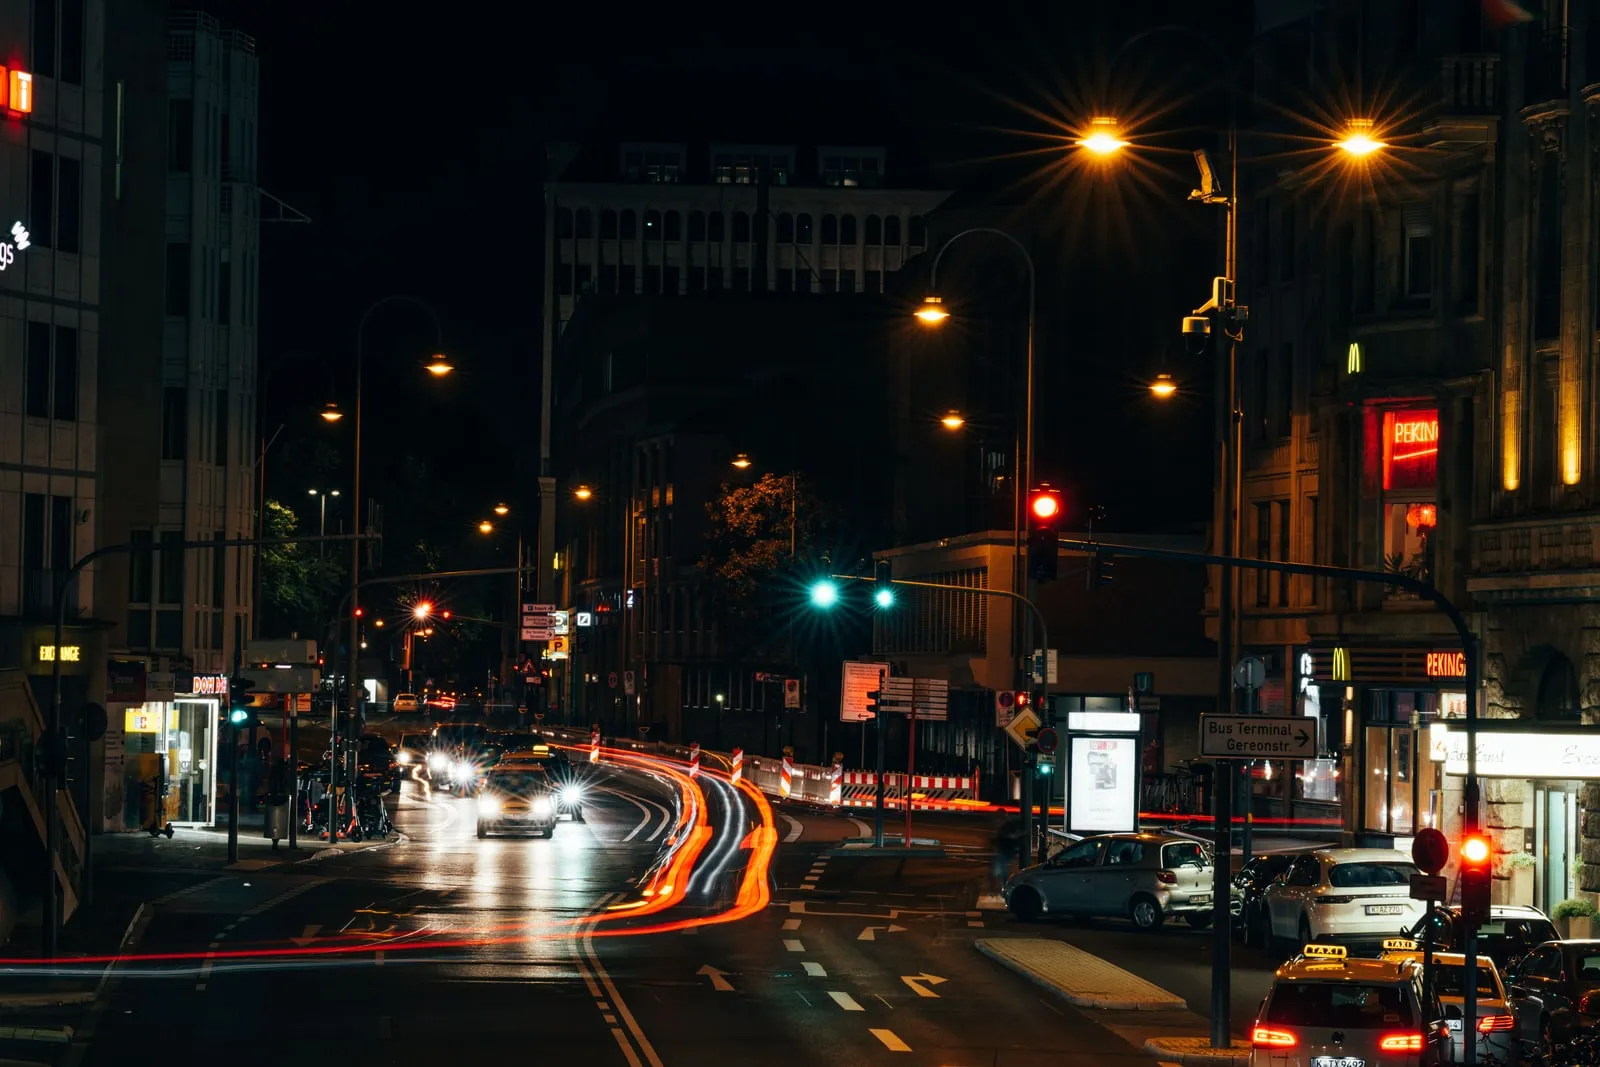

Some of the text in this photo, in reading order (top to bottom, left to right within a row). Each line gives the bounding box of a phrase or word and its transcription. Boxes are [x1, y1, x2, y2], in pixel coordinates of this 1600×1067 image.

[1427, 652, 1464, 677] PEKING
[1209, 721, 1292, 735] Bus Terminal
[1227, 739, 1292, 752] Gereonstr.
